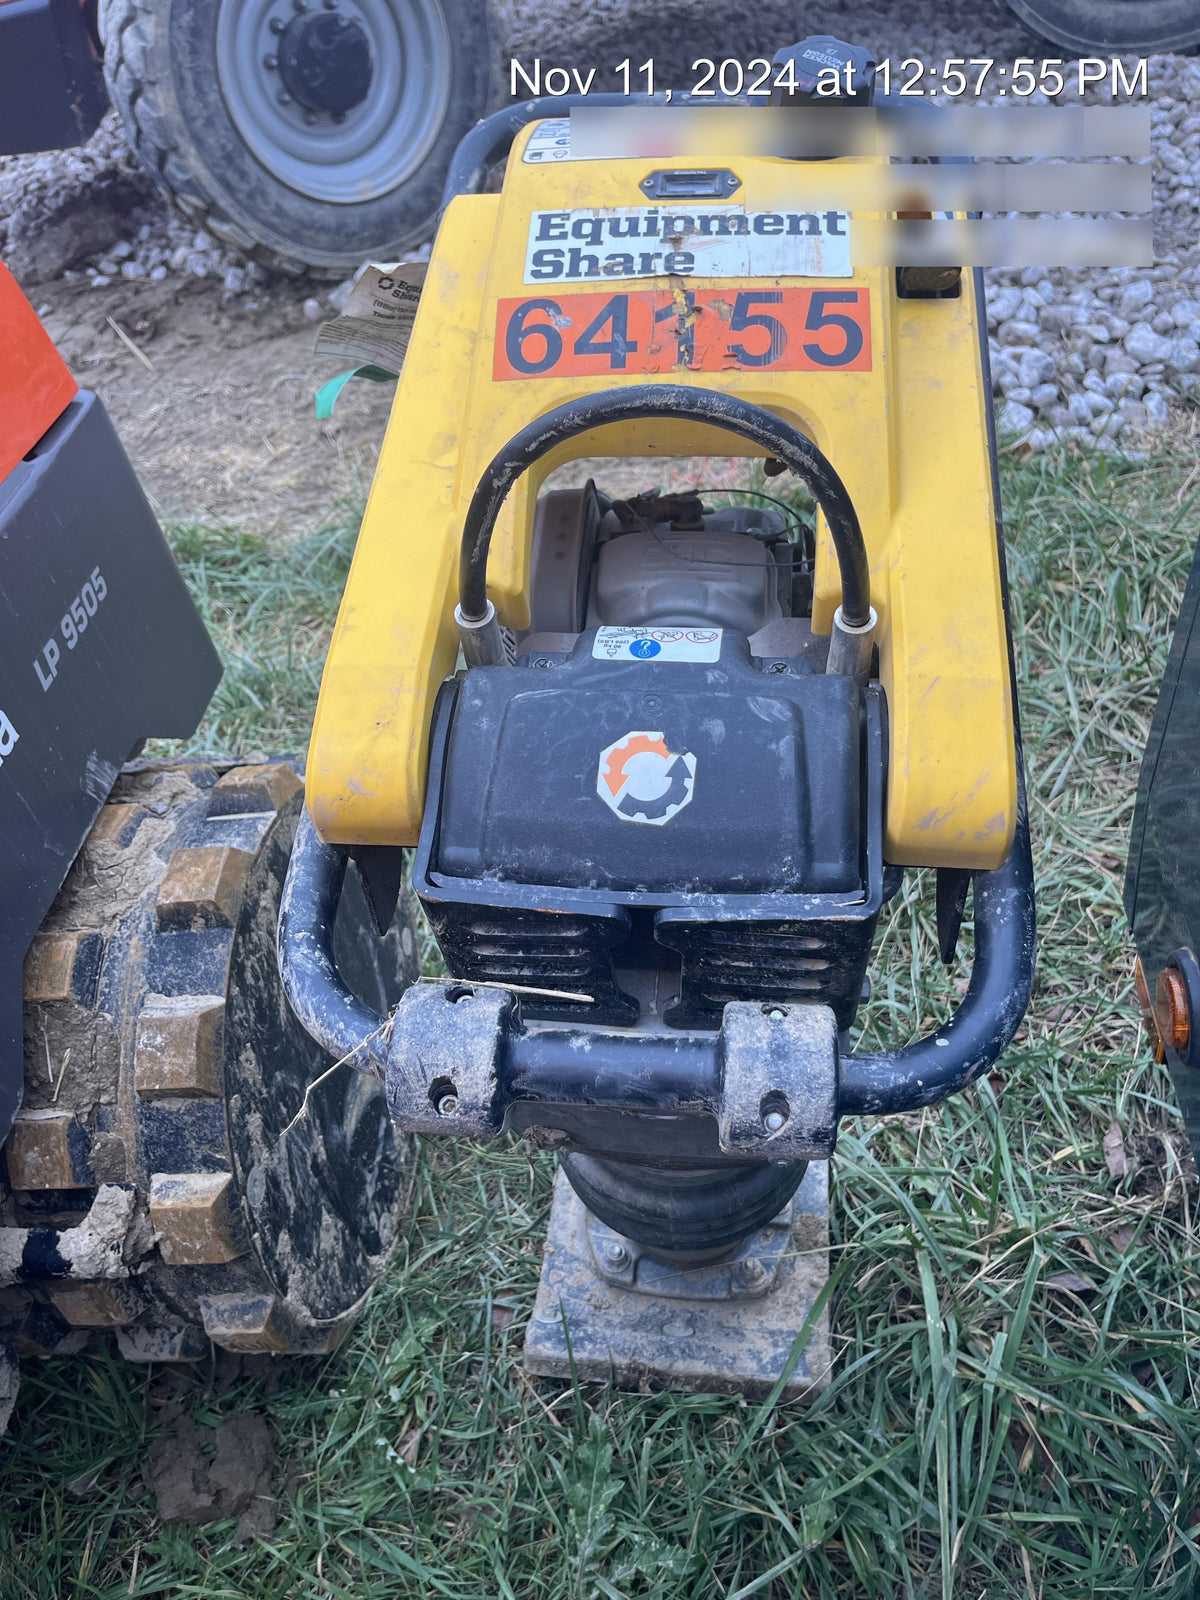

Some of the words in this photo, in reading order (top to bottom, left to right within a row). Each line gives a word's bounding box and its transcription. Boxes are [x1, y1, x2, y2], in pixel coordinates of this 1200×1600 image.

[535, 210, 846, 246] Equipment
[531, 247, 695, 280] Share
[506, 291, 863, 374] 64155
[33, 638, 60, 692] LP
[61, 566, 108, 650] 9505
